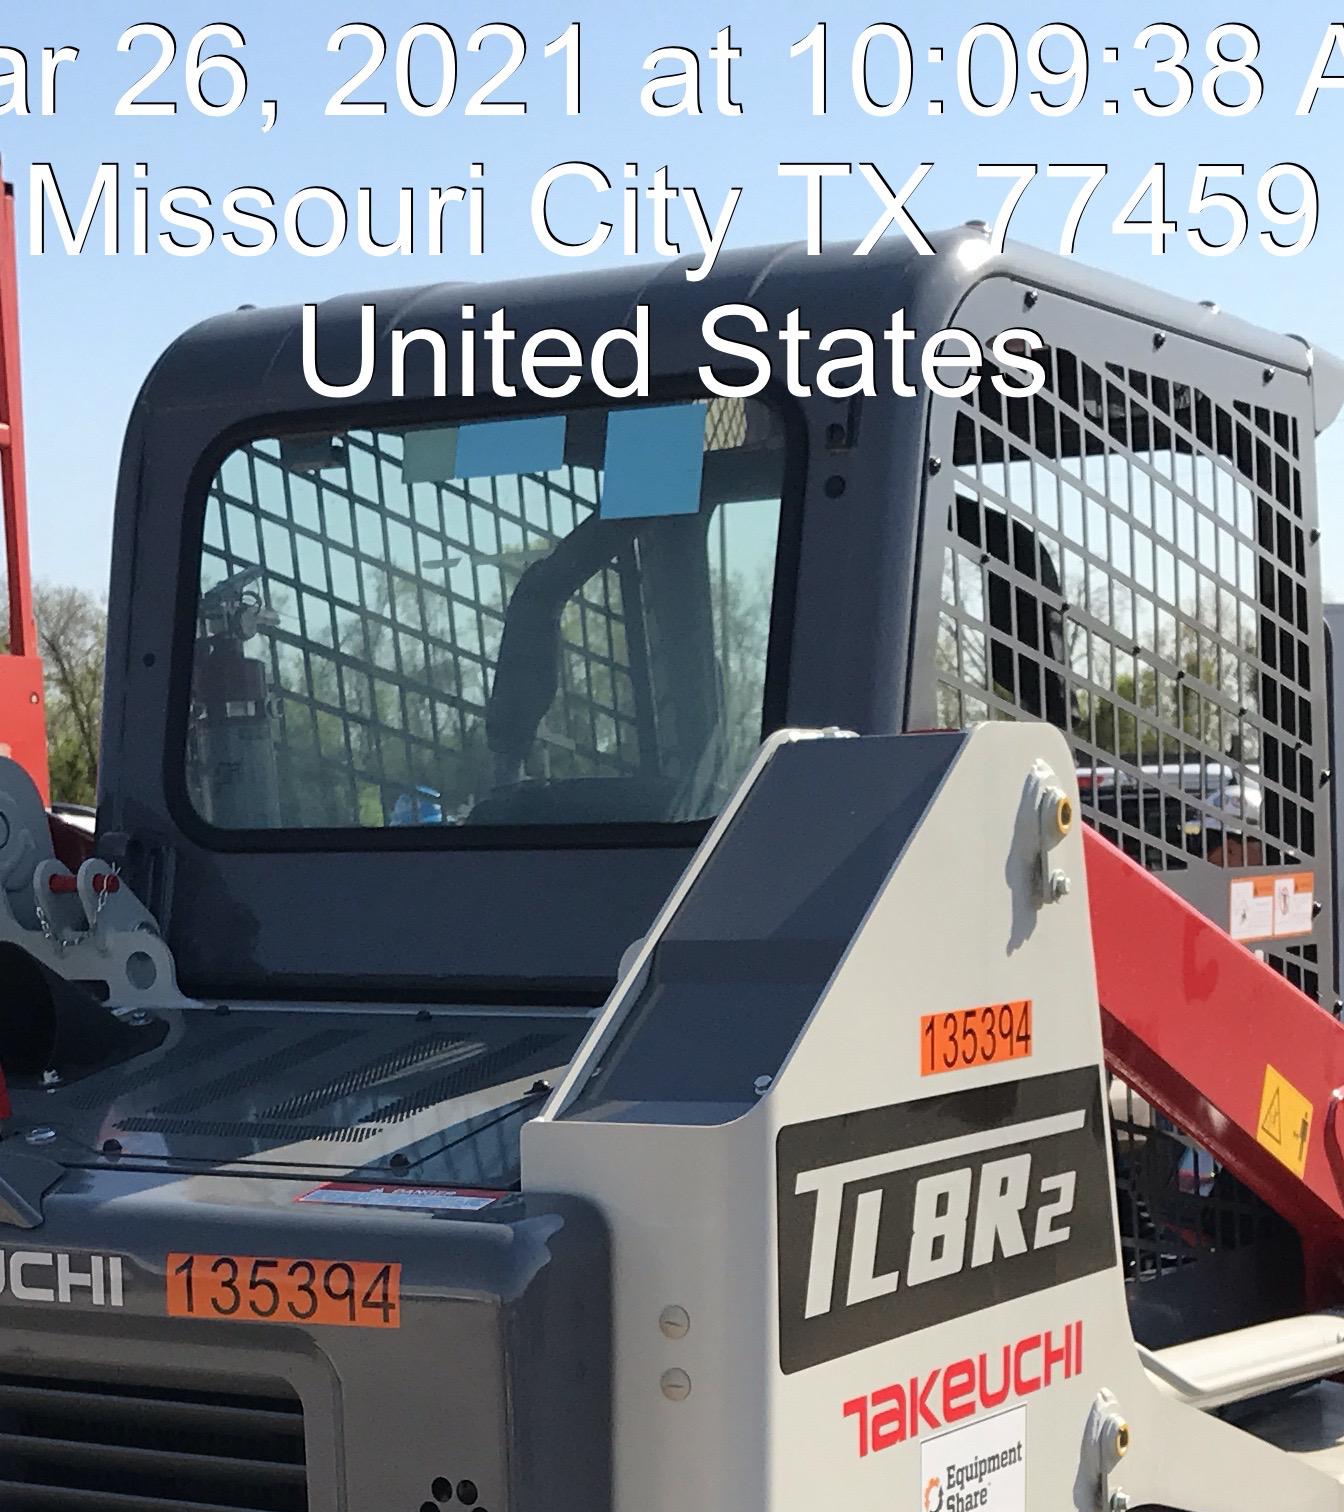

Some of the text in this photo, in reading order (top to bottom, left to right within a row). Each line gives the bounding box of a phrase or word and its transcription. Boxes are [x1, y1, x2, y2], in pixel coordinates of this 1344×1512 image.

[924, 1001, 1032, 1071] 135394
[173, 1254, 398, 1324] 135394
[946, 1440, 1023, 1491] Equipment
